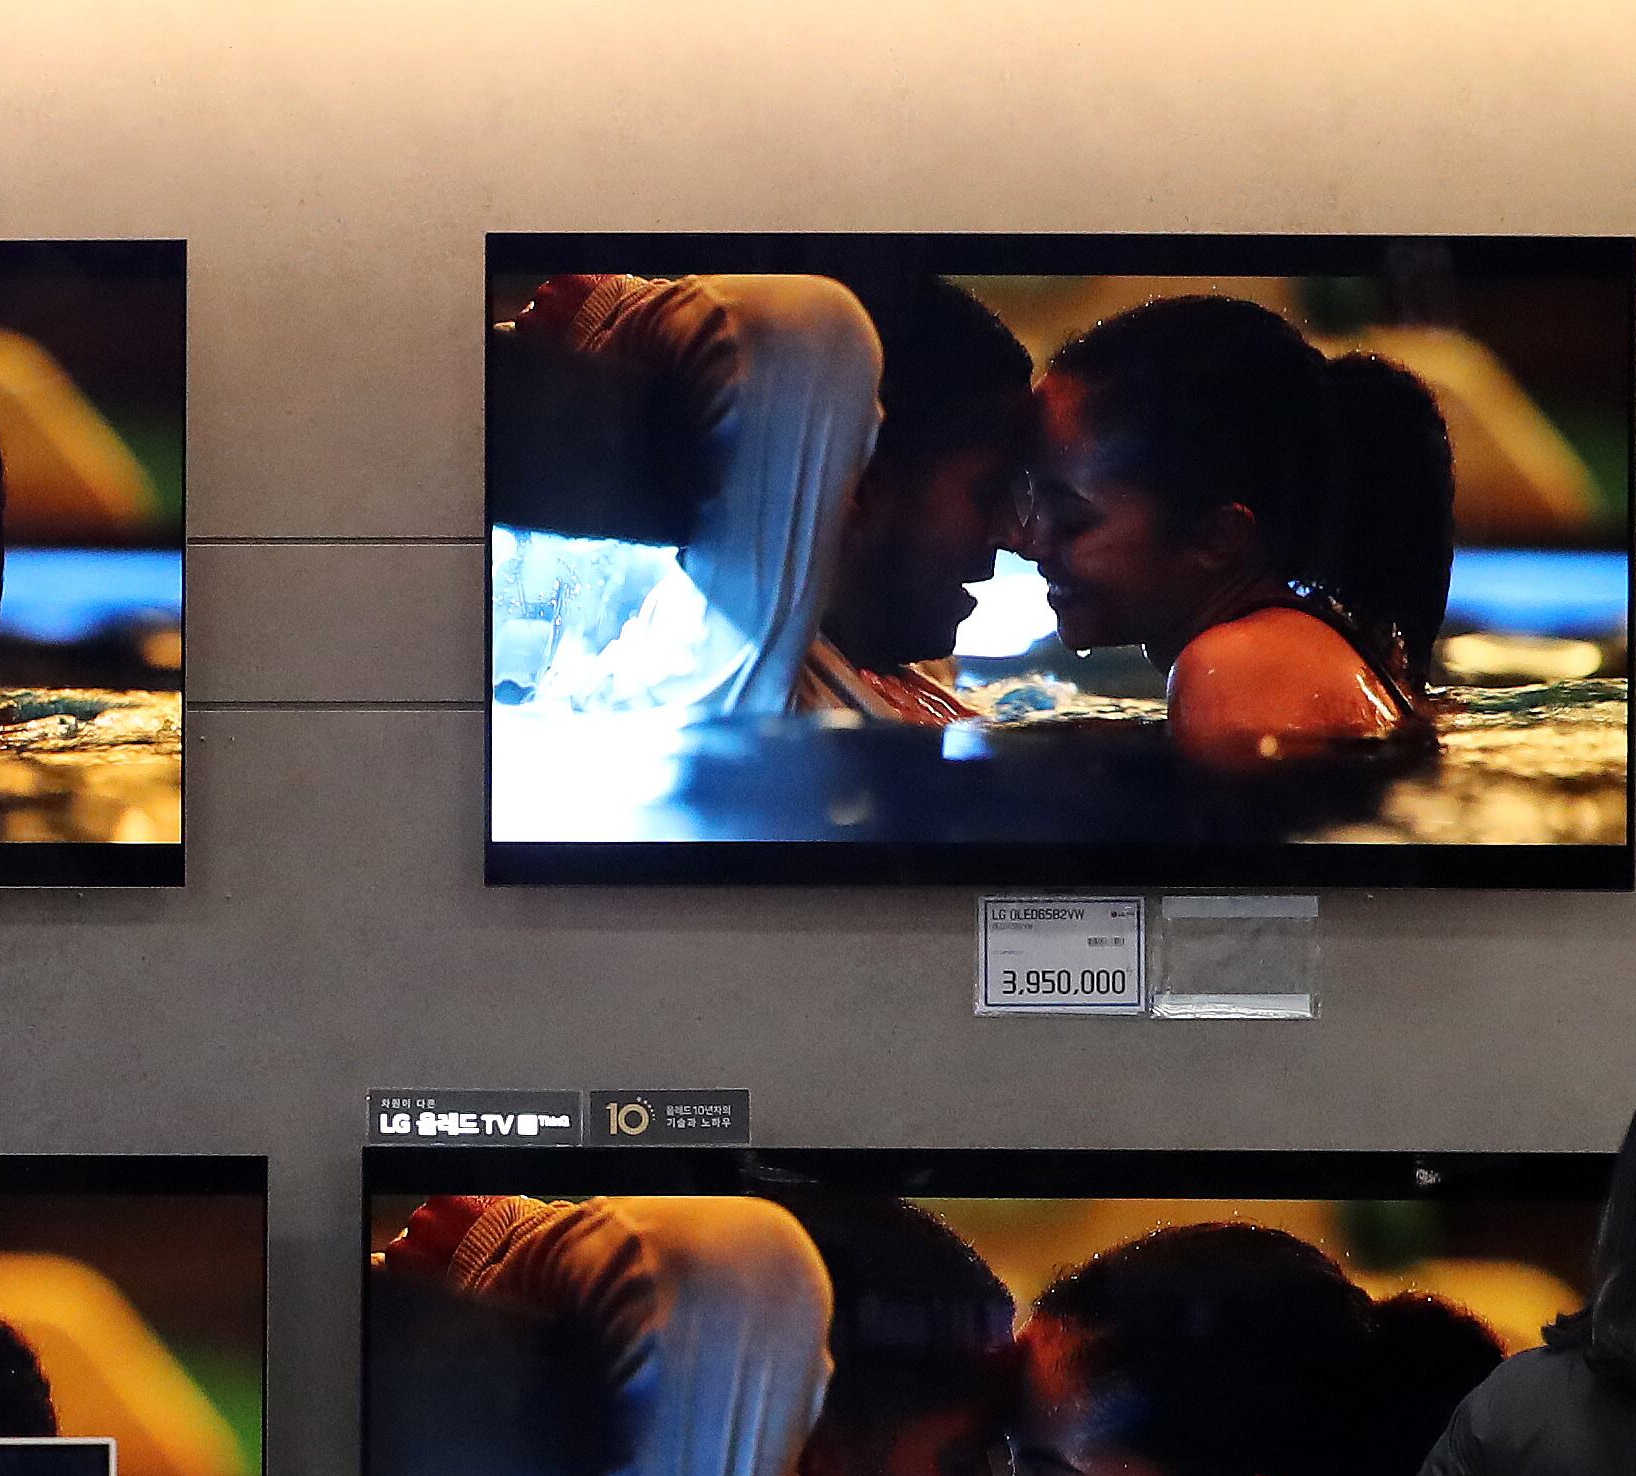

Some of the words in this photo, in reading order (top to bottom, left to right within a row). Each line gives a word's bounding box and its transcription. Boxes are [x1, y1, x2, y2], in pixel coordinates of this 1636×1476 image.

[992, 909, 1006, 920] LG
[1002, 969, 1126, 995] 3,950,000
[416, 1099, 435, 1109] 다른
[380, 1113, 411, 1133] LG
[416, 1112, 479, 1135] 올레드
[481, 1114, 515, 1135] TV
[606, 1102, 649, 1135] 10
